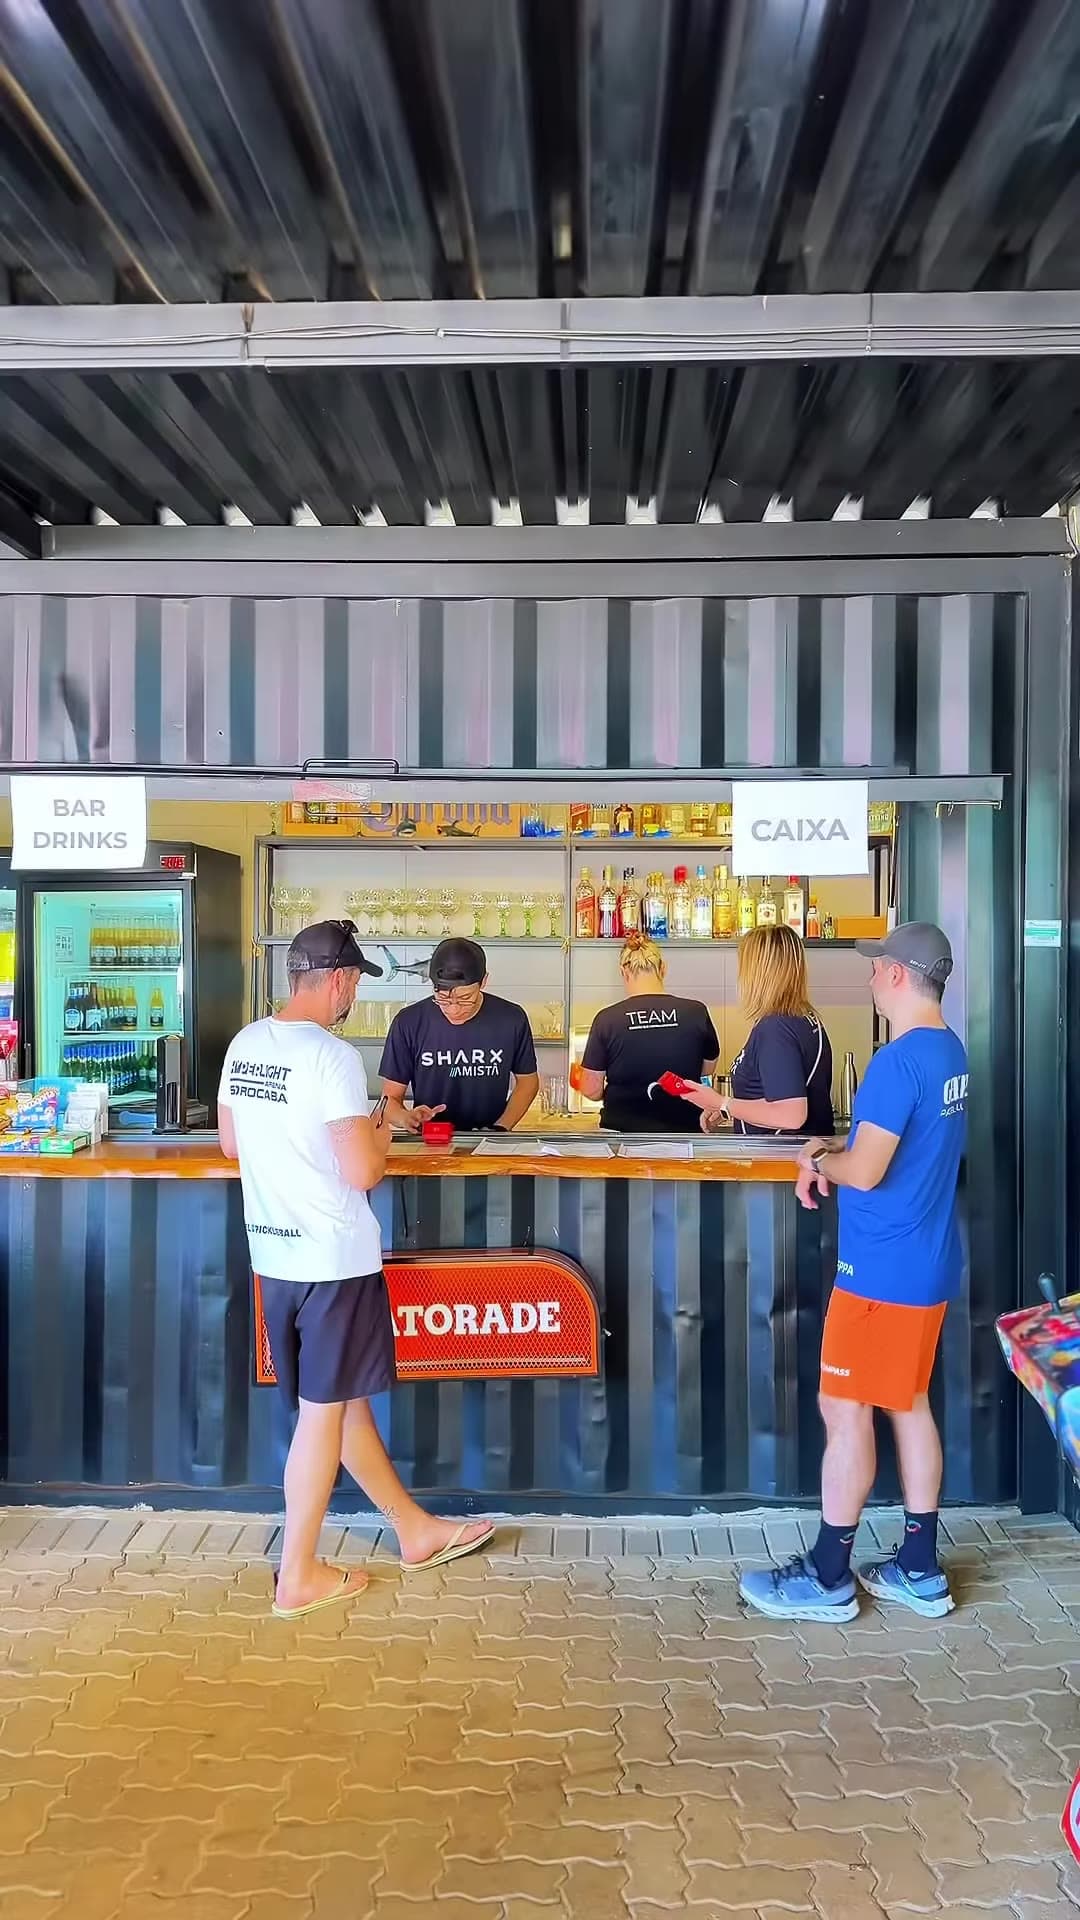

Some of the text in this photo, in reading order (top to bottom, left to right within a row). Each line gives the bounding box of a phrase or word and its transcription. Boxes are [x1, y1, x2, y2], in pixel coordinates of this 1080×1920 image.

[53, 799, 106, 817] BAR
[751, 818, 850, 842] CAIXA
[33, 831, 128, 849] DRINKS
[625, 1008, 677, 1025] TEAM
[421, 1049, 503, 1067] SHARX
